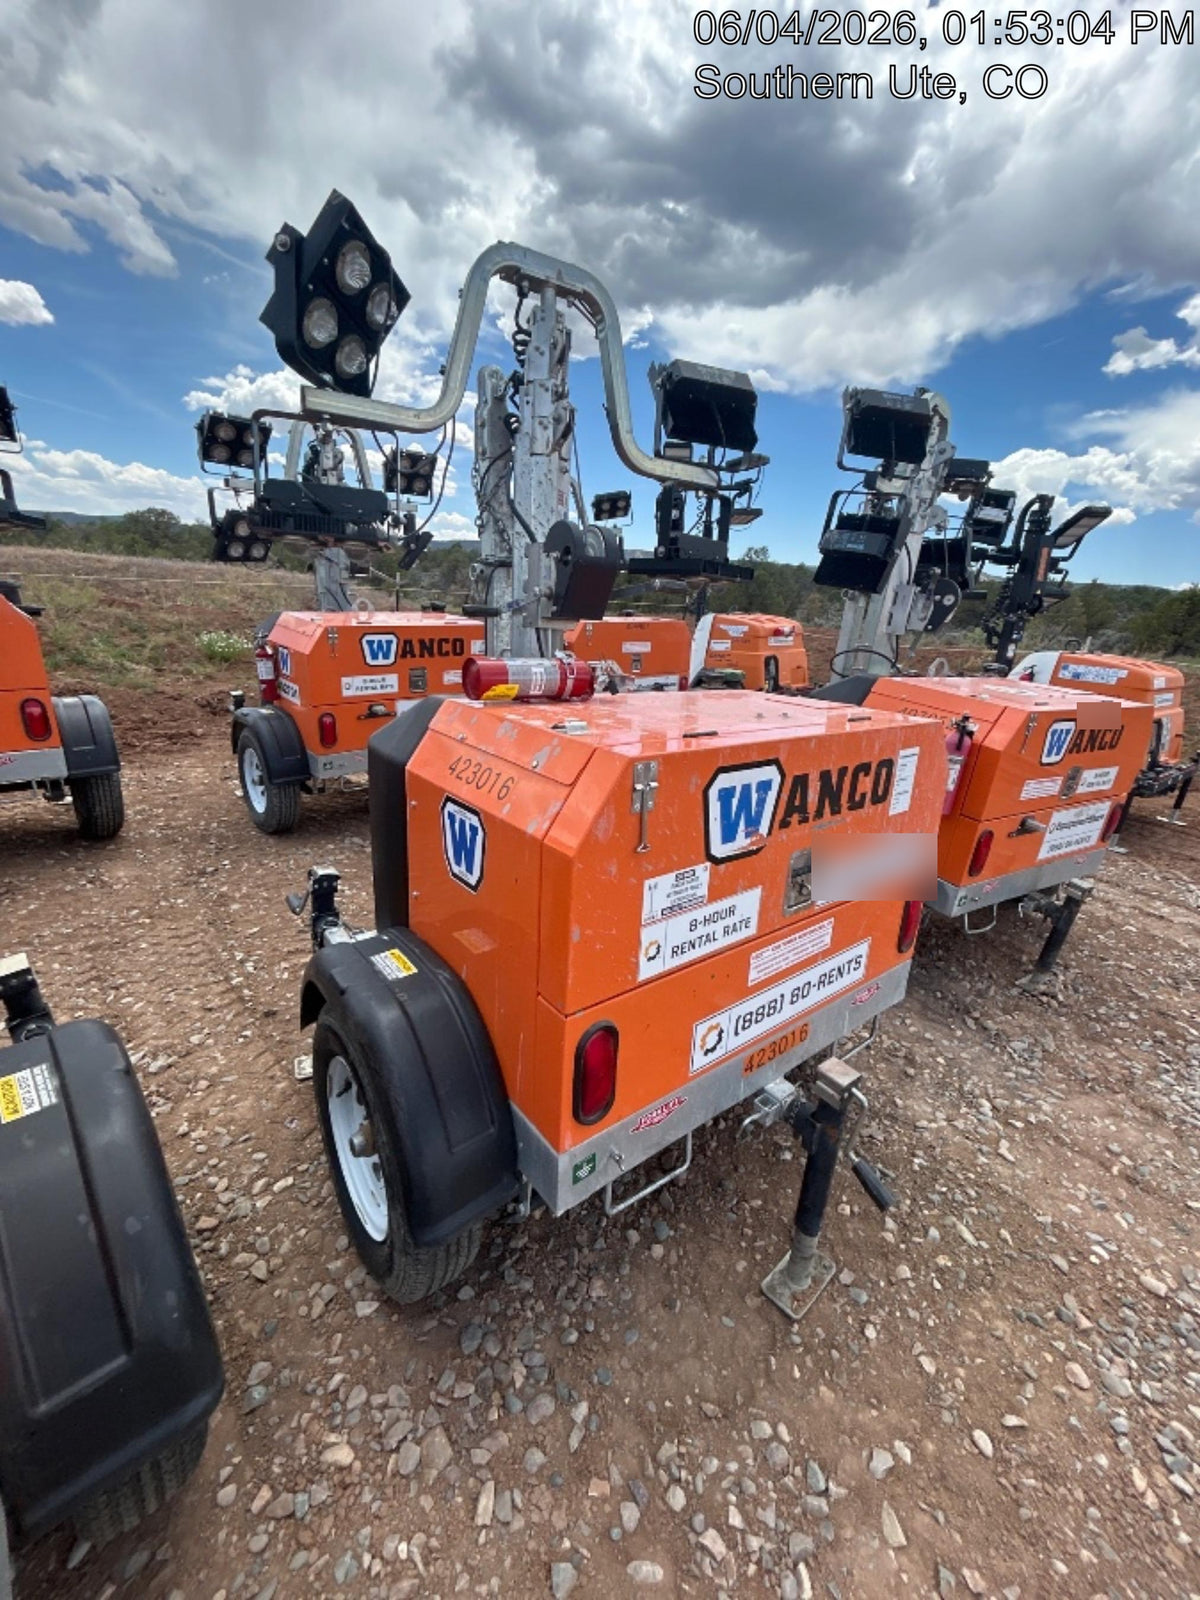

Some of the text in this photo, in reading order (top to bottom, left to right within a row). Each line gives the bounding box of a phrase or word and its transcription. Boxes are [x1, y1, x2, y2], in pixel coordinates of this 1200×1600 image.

[365, 637, 465, 661] WANCO
[448, 756, 516, 800] 423016
[717, 757, 895, 846] WANCO
[671, 917, 751, 959] RENTAL RATE
[689, 904, 737, 932] 8-HOUR
[733, 993, 785, 1036] (888)
[744, 1023, 809, 1073] 423016
